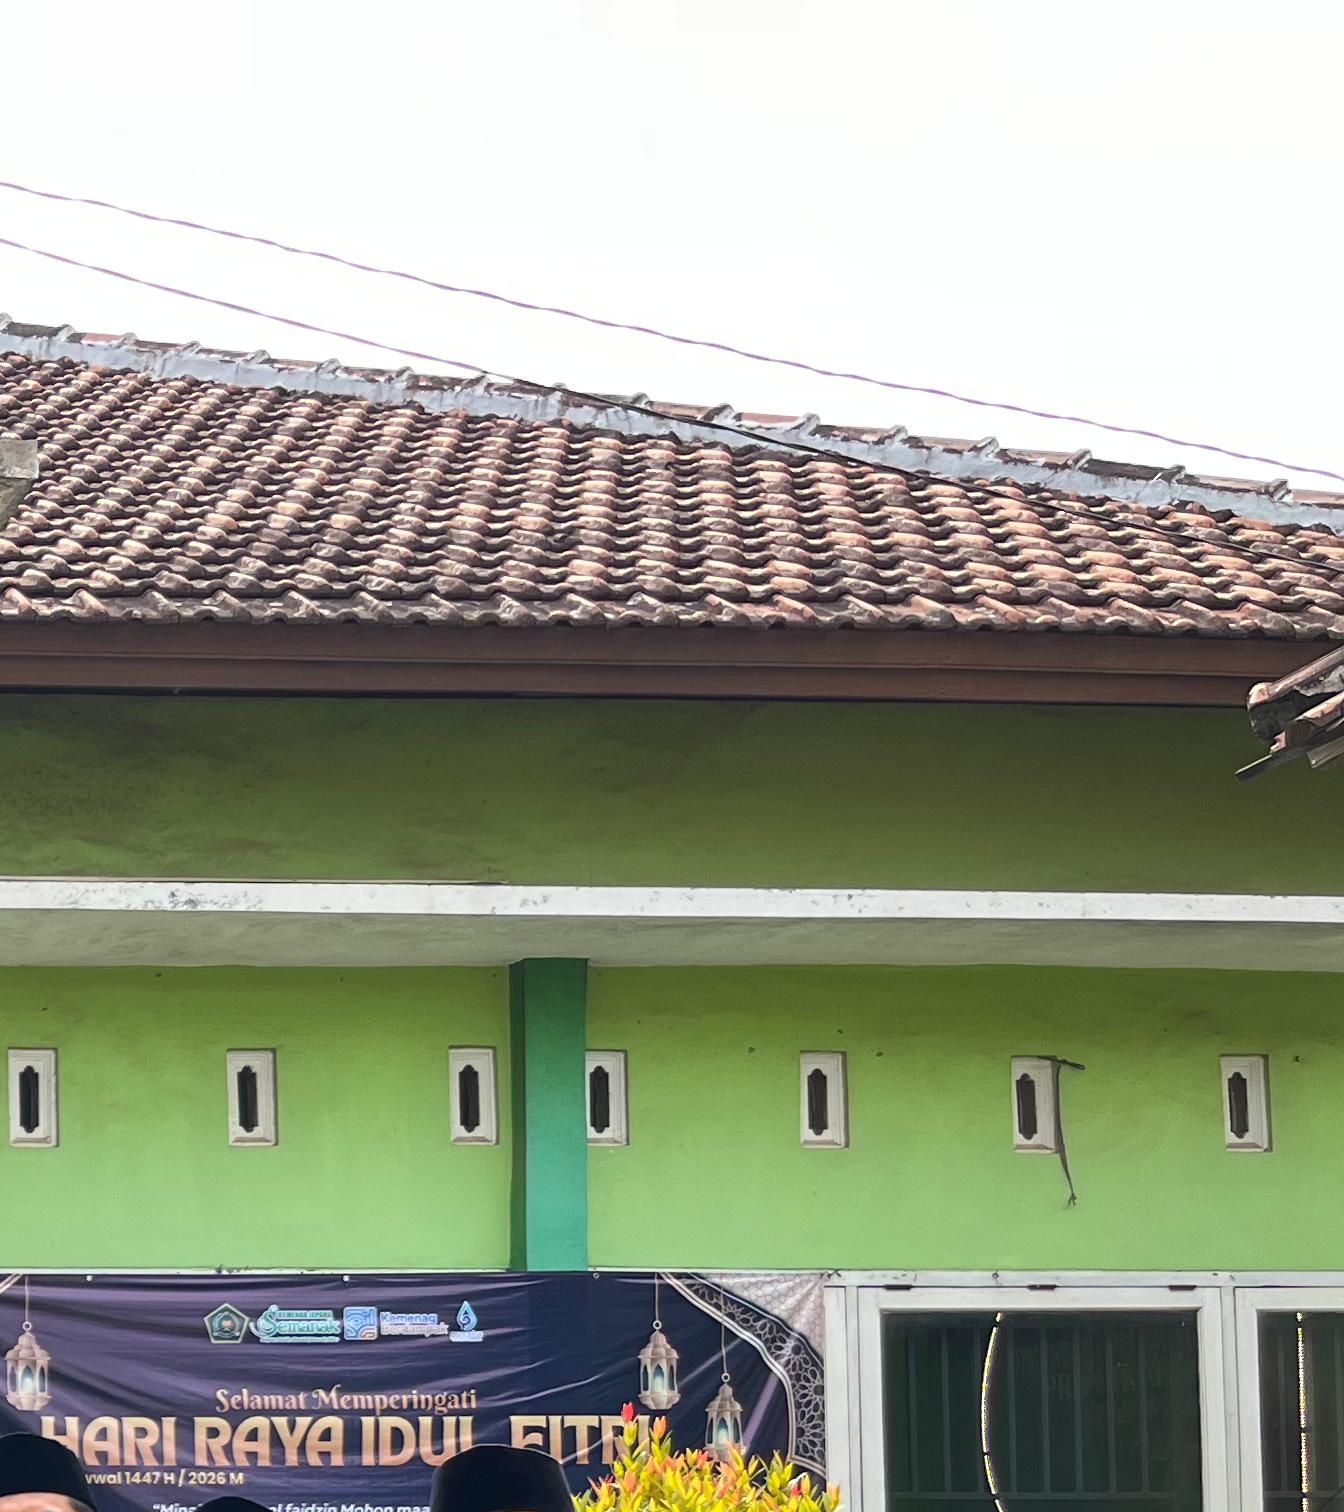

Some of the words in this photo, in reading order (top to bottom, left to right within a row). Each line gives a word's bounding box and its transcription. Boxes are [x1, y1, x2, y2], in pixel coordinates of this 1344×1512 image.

[215, 1388, 308, 1413] Selamat
[312, 1384, 478, 1416] Memperingati
[41, 1415, 178, 1467] HARI
[193, 1415, 345, 1467] RAYA
[124, 1471, 161, 1485] 1447
[163, 1472, 175, 1485] H
[188, 1472, 226, 1485] 2026
[229, 1472, 244, 1485] M
